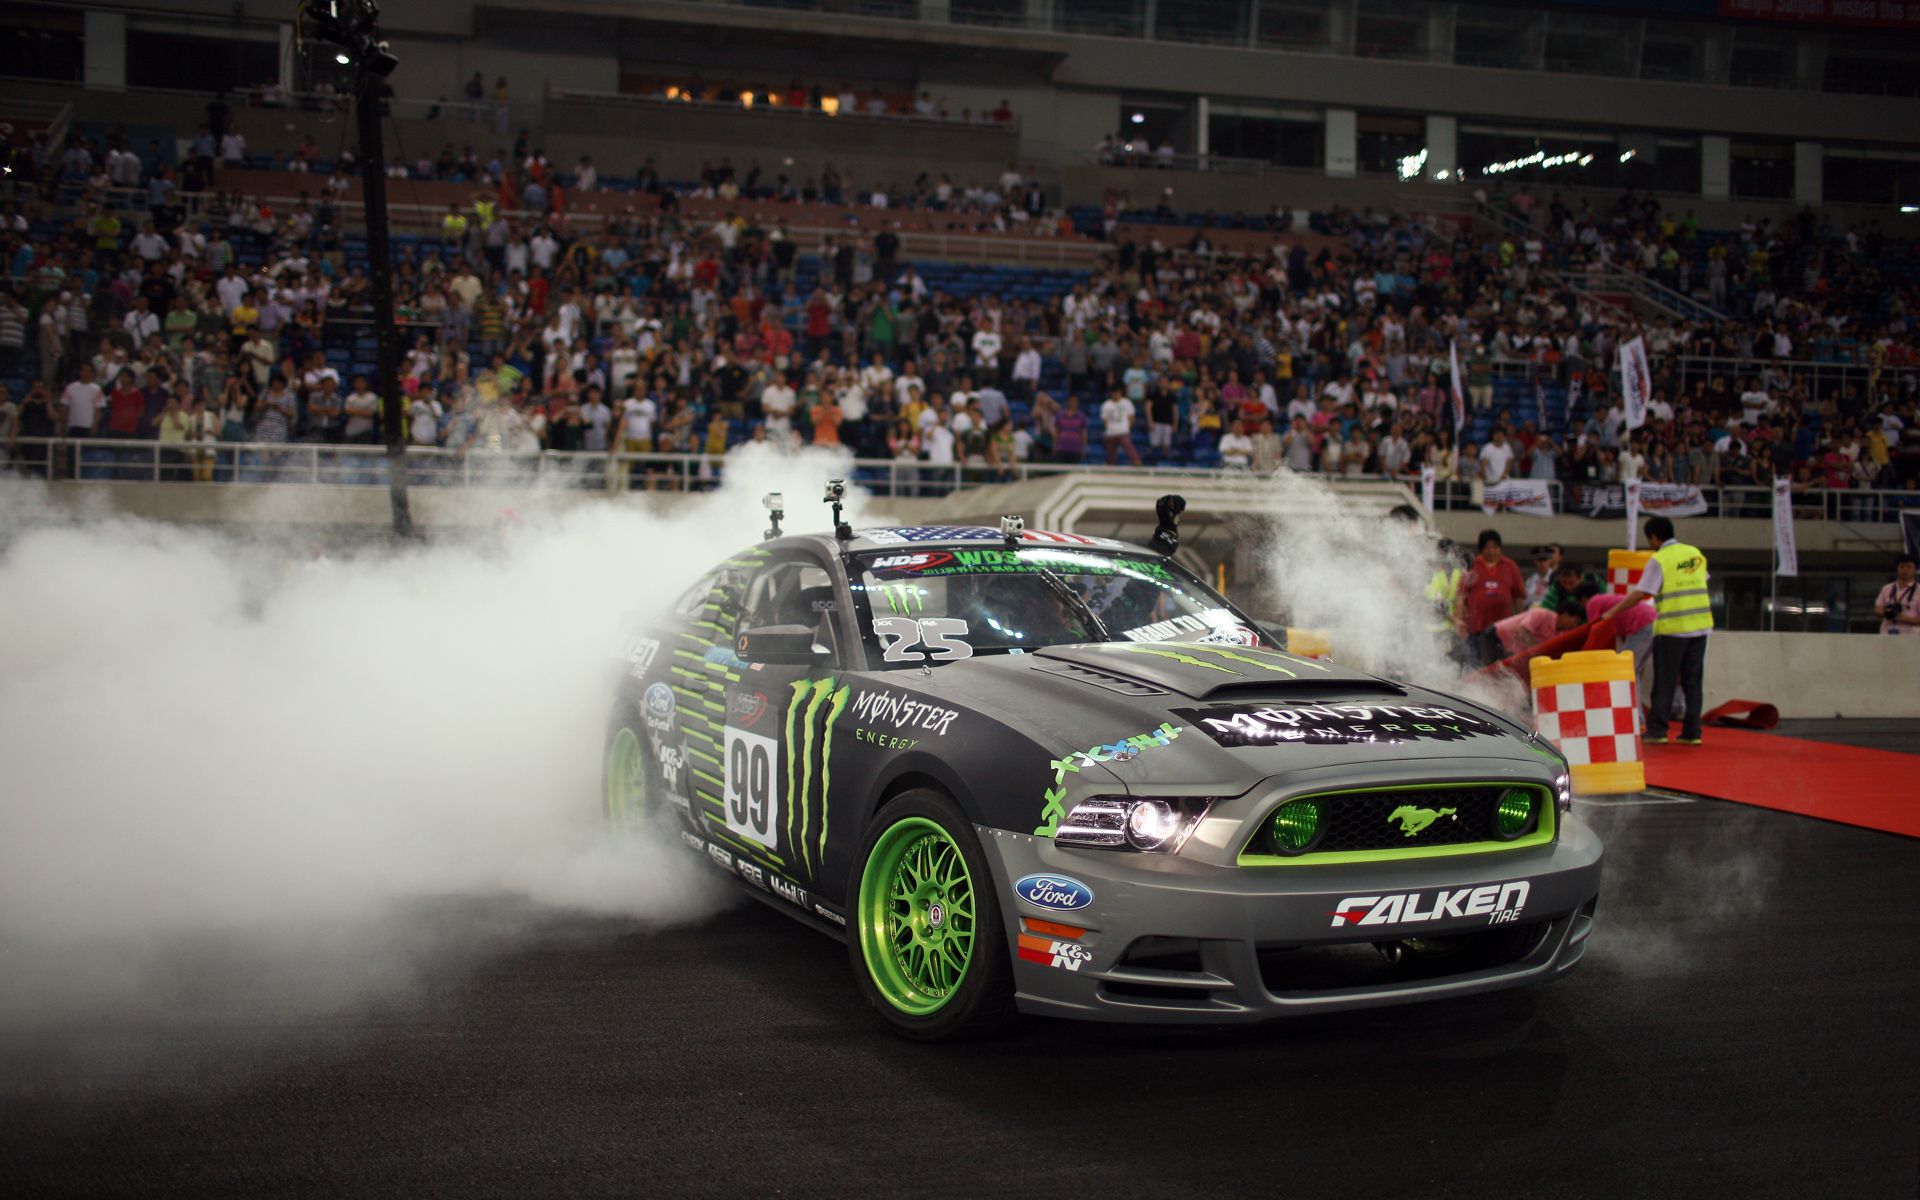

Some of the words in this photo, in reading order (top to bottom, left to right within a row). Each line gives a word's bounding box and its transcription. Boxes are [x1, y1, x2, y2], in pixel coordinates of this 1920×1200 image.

[872, 554, 930, 568] WDS
[872, 617, 974, 662] 25
[855, 728, 919, 750] ENERGY
[731, 738, 770, 835] 99
[1030, 878, 1079, 906] Ford
[1328, 880, 1531, 927] FALKEN
[1488, 907, 1523, 926] TIRE
